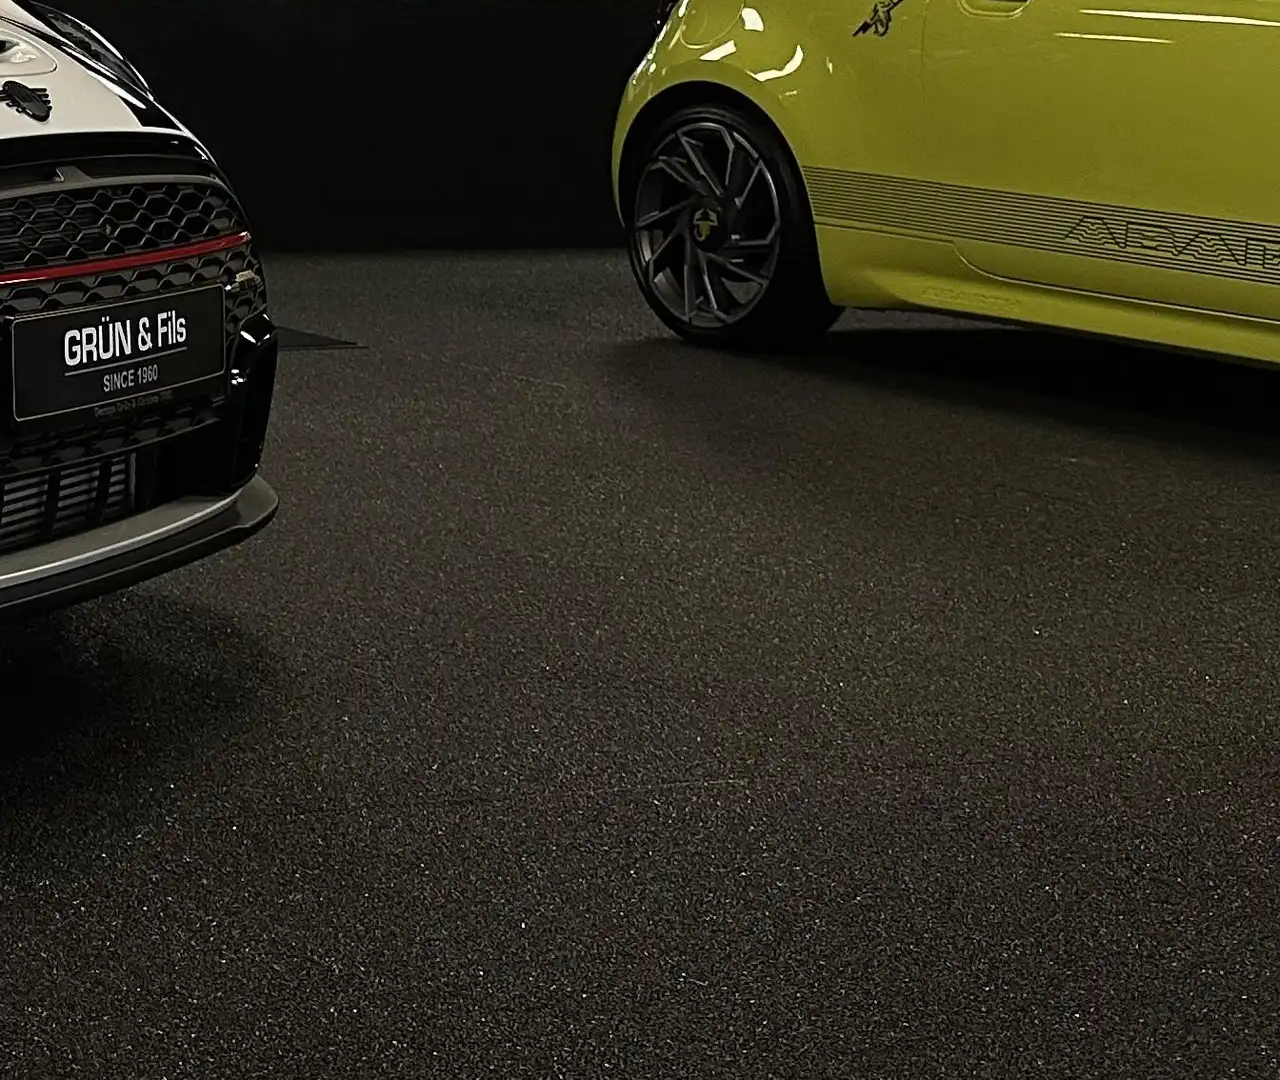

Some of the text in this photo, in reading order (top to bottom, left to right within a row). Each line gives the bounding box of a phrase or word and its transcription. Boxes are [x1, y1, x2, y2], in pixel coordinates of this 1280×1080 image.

[63, 309, 187, 367] GRÜN & Fils
[103, 363, 159, 393] SINCE 1960
